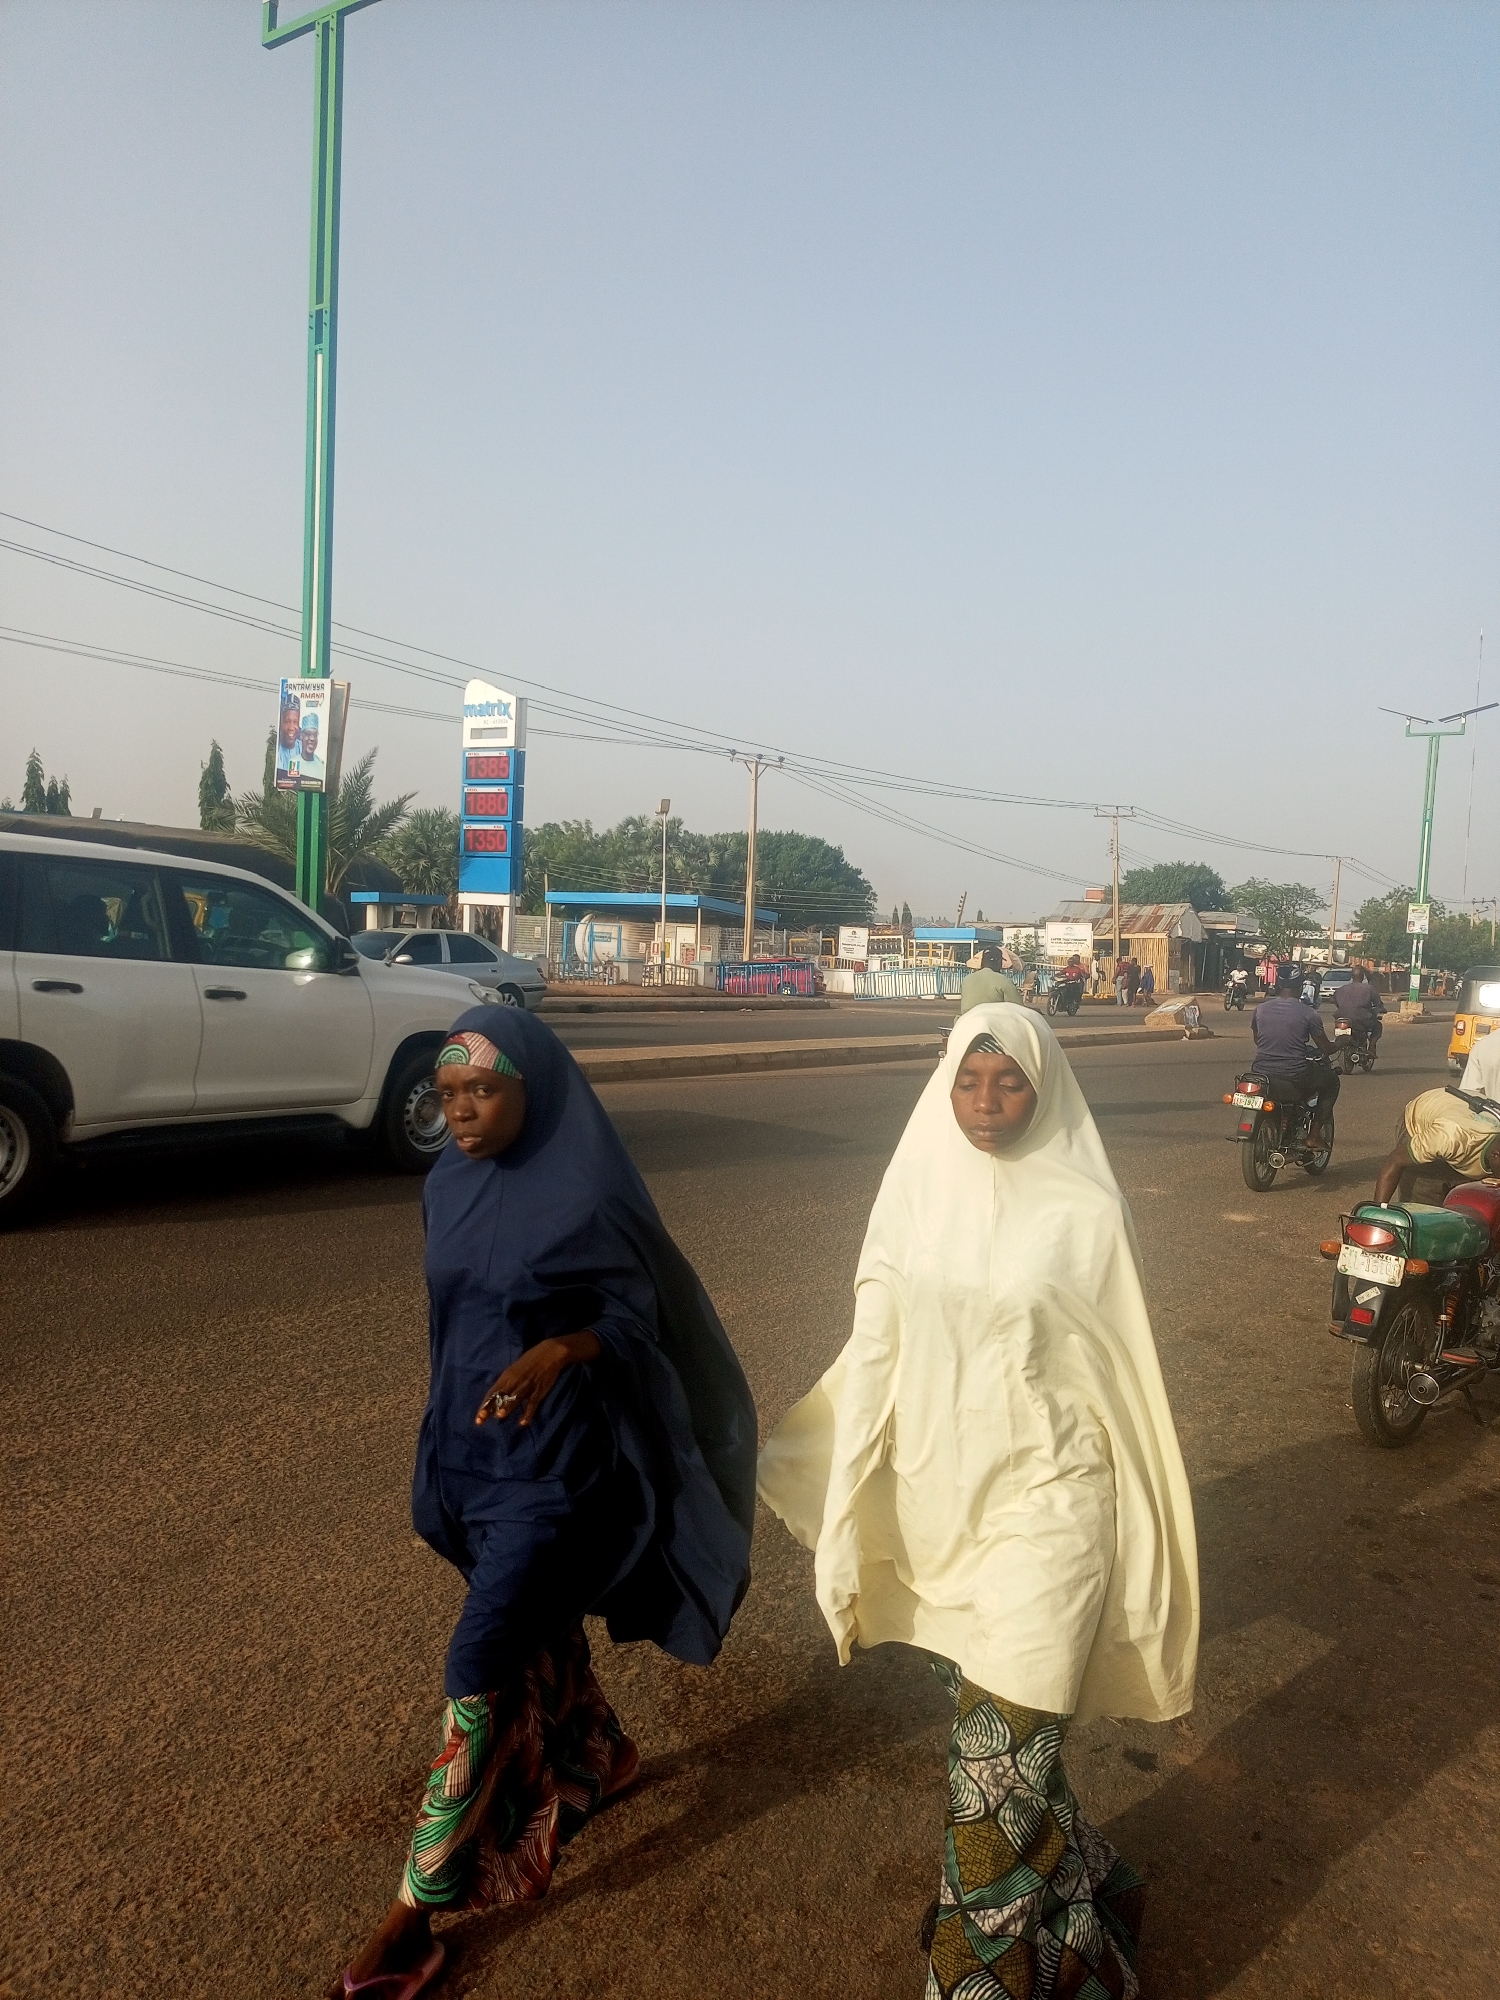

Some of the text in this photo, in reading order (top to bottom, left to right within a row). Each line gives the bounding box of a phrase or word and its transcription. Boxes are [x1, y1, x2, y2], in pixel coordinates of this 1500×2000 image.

[463, 699, 513, 721] matrix
[468, 756, 510, 778] 1385
[467, 793, 508, 815] 1880
[466, 830, 507, 851] 1350
